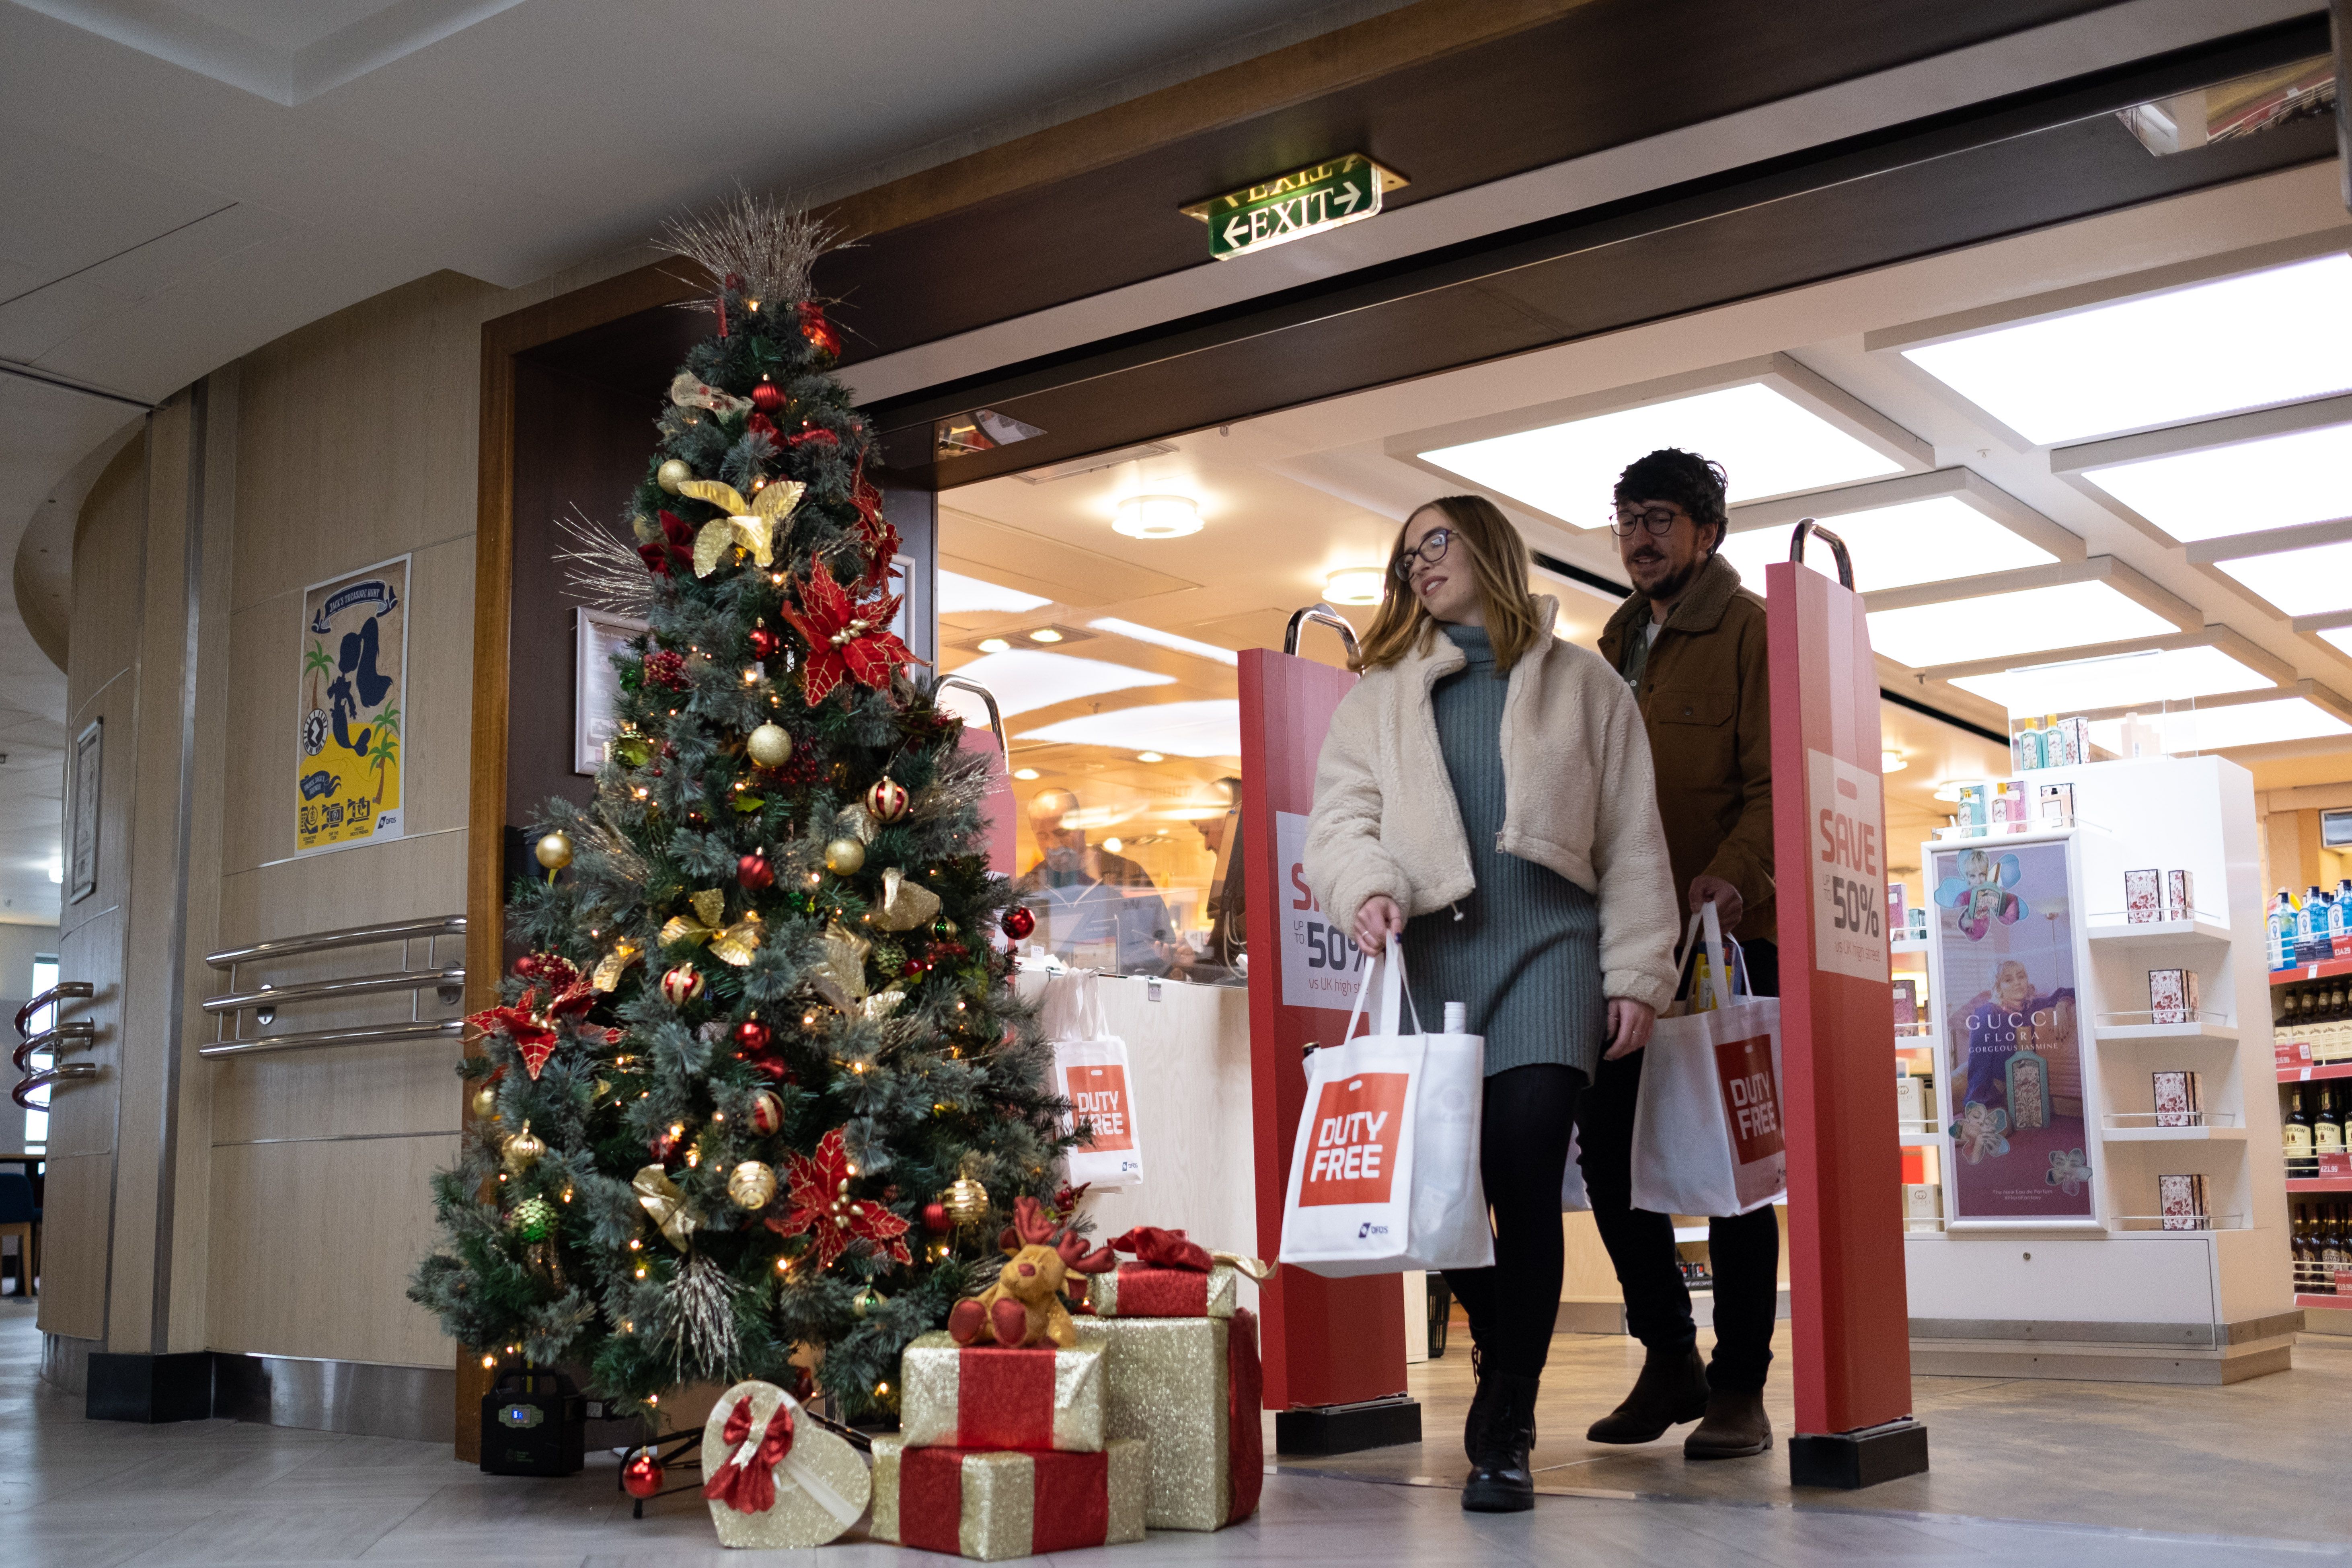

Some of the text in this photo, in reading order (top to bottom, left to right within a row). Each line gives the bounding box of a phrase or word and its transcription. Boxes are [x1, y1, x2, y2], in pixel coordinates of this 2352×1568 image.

[1248, 187, 1335, 244] EXIT
[345, 589, 367, 603] TREASURE
[1820, 808, 1876, 877] SAVE
[1832, 876, 1879, 938] 50%
[1294, 920, 1304, 931] UP
[1294, 933, 1304, 944] TO
[1308, 979, 1319, 989] vs
[1321, 978, 1332, 991] UK
[1334, 979, 1352, 996] high
[1966, 1010, 2058, 1030] GUCCI
[1968, 1043, 2058, 1053] GORGEOUS JASMINE
[1985, 1032, 2039, 1042] FLORA
[1730, 1071, 1770, 1107] DUTY
[1077, 1091, 1119, 1113] DUTY
[1318, 1111, 1388, 1147] DUTY
[1737, 1102, 1777, 1141] FREE
[1310, 1144, 1383, 1182] FREE
